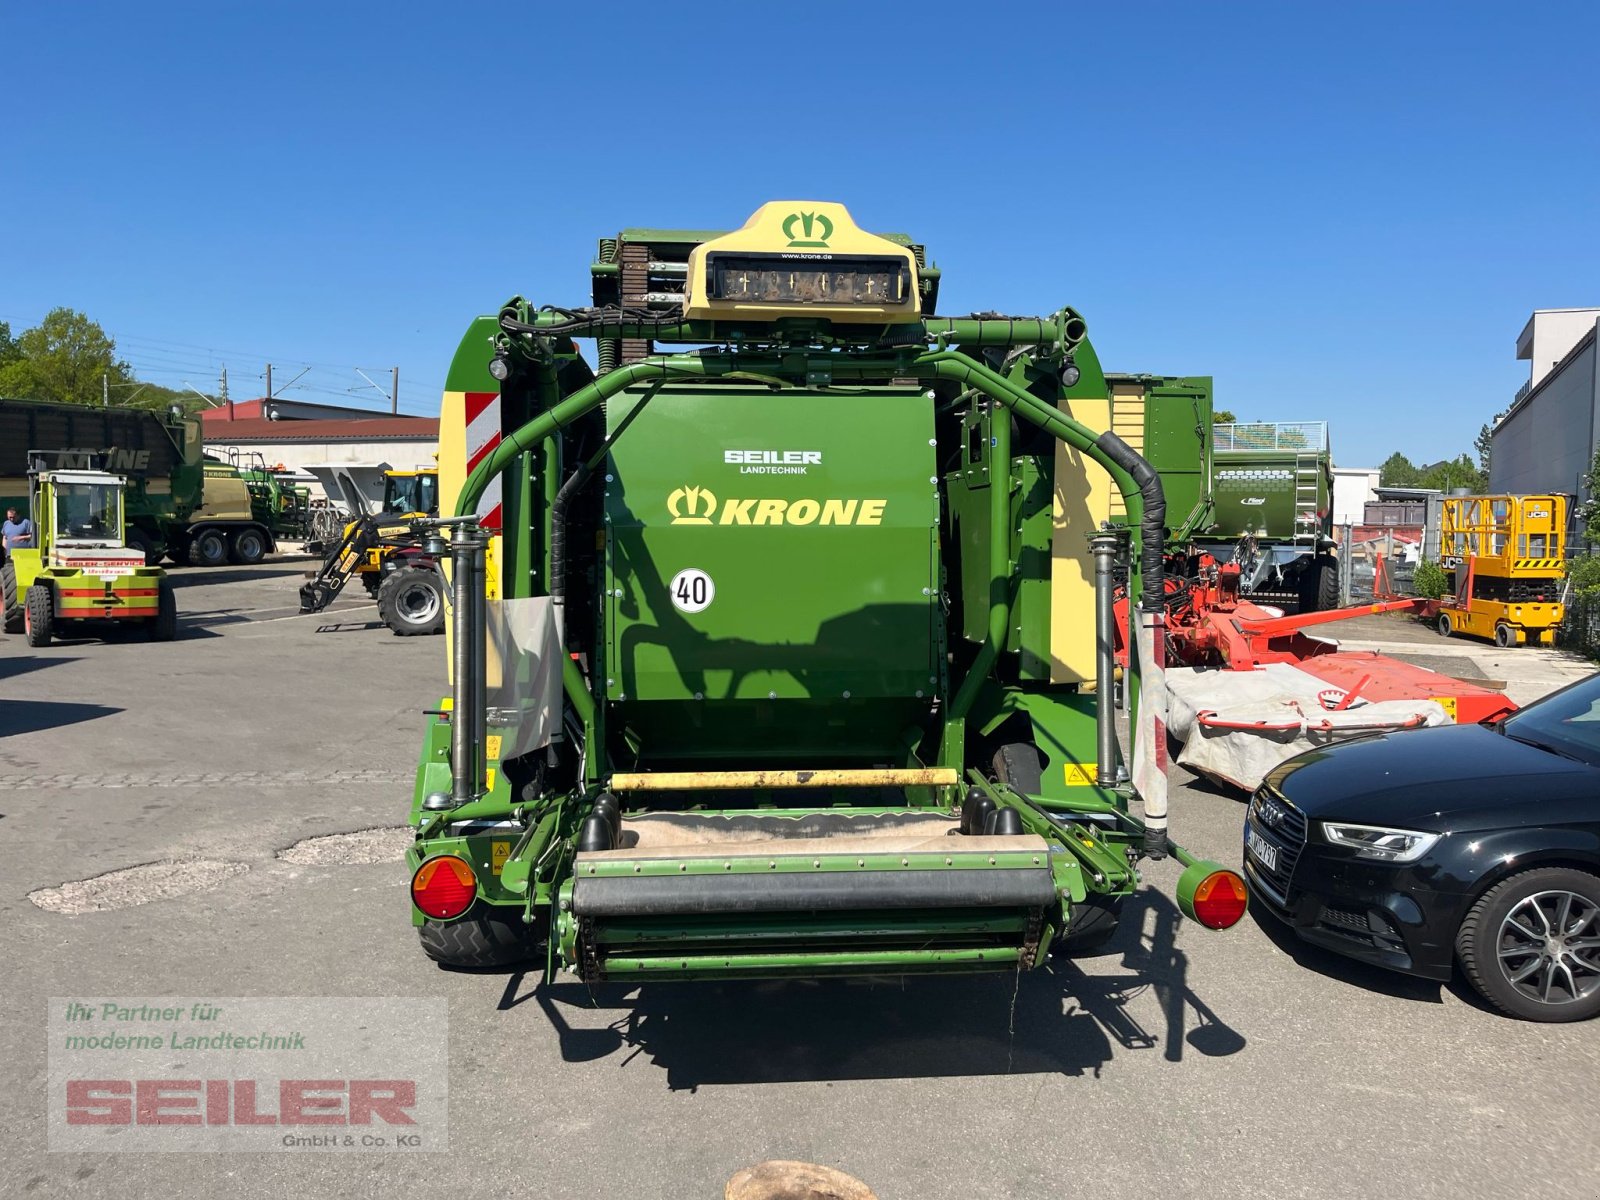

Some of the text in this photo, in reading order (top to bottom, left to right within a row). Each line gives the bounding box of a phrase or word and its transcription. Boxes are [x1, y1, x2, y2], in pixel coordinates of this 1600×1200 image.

[724, 450, 822, 465] SEILER
[740, 466, 807, 475] LANDTECHNIK
[719, 499, 888, 526] KRONE
[676, 577, 706, 604] 40
